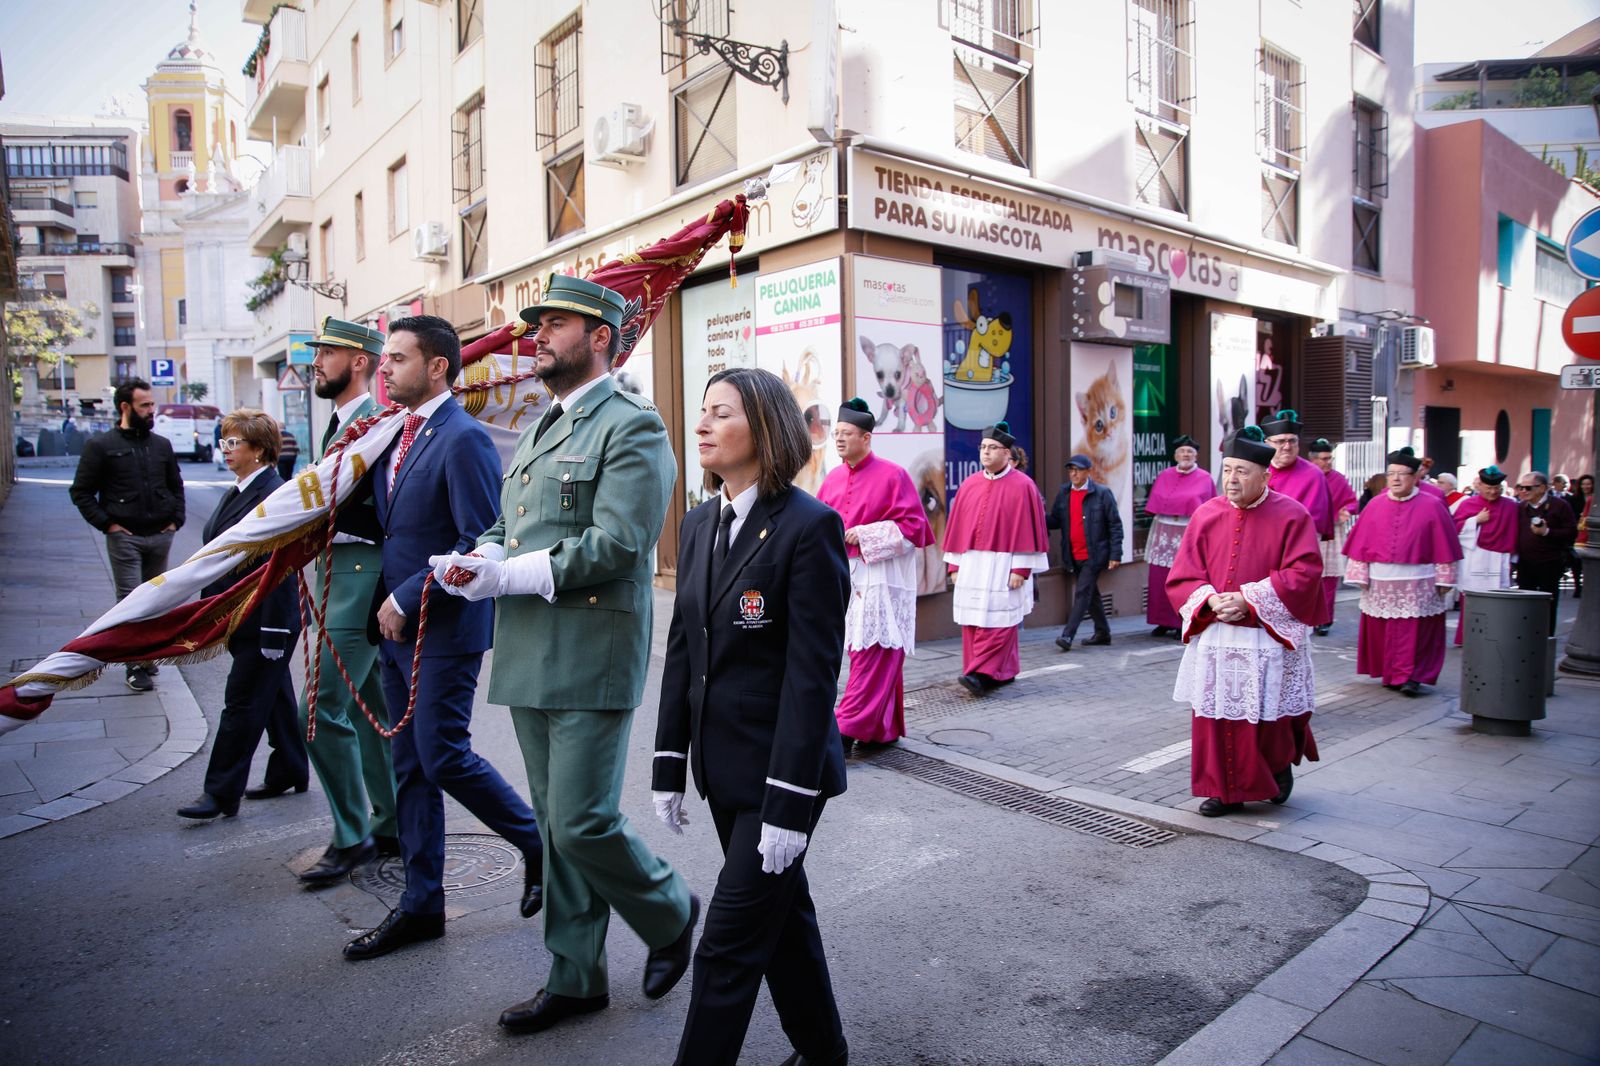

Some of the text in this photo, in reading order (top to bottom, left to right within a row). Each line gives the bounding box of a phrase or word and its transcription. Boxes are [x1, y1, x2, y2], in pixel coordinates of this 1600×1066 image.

[874, 166, 1073, 233] TIENDA ESPECIALIZADA
[874, 197, 1042, 252] PARA SU MASCOTA
[760, 269, 836, 300] PELUQUERIA
[774, 292, 821, 316] CANINA
[707, 328, 740, 342] canina y
[707, 346, 726, 357] todo
[156, 360, 170, 376] P
[708, 362, 726, 375] para
